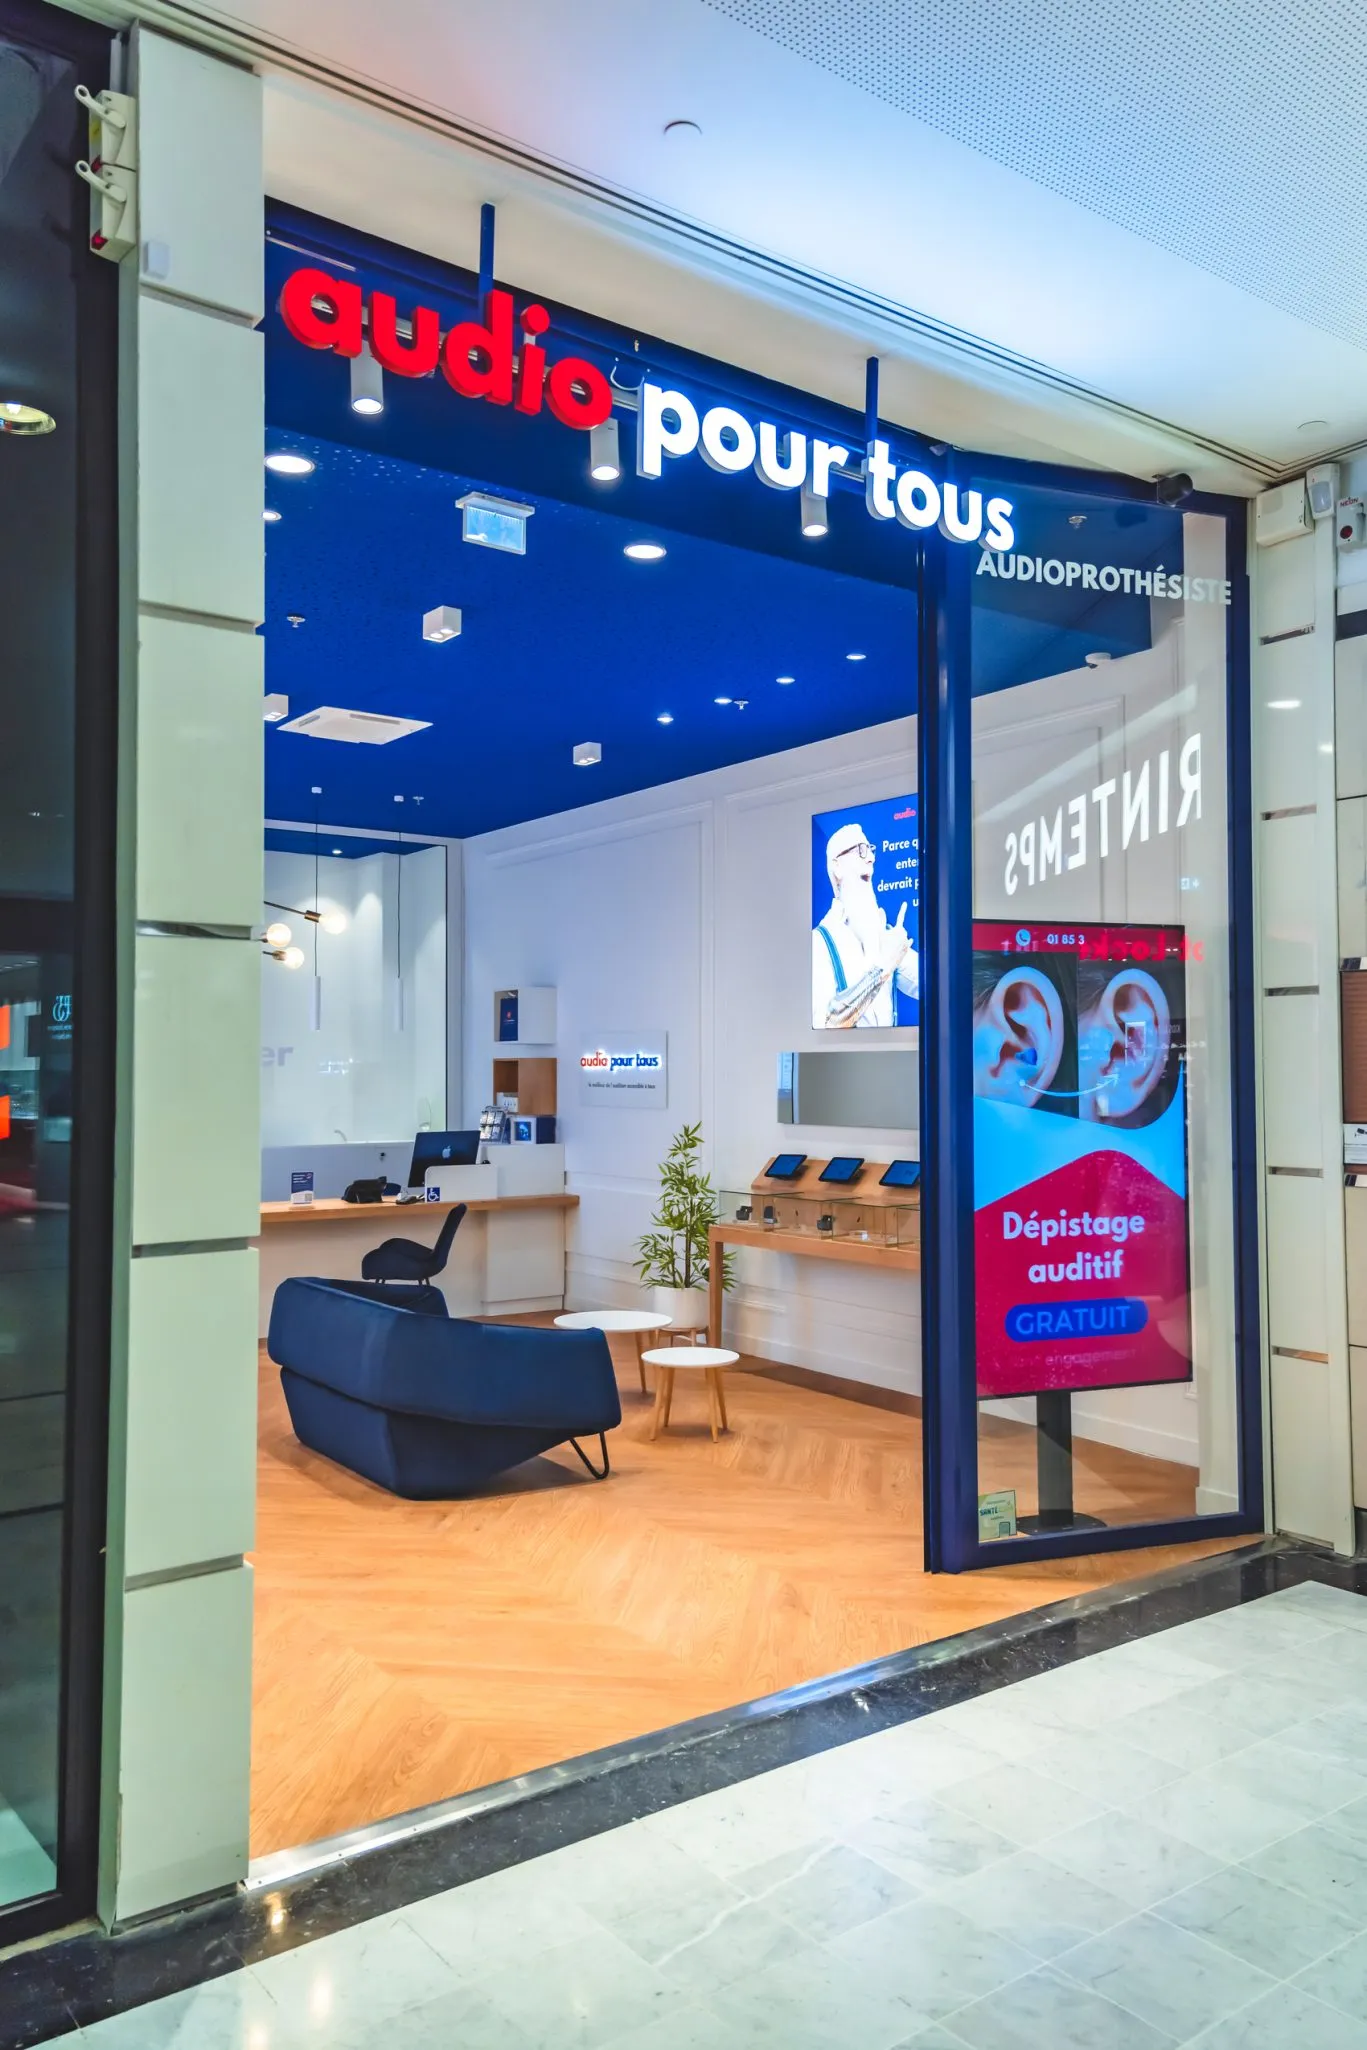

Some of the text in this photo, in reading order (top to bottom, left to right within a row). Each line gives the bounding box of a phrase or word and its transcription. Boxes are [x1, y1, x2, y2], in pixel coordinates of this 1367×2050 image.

[281, 267, 1015, 553] audio pour tous
[975, 551, 1233, 605] AUDIOPROTHÉSISTE
[882, 839, 910, 852] Parce
[896, 858, 918, 869] ente
[877, 876, 912, 892] devrait
[1047, 934, 1058, 945] 01
[1062, 934, 1075, 945] 85
[580, 1051, 659, 1071] audio pour tous
[1003, 1209, 1145, 1246] Dépistage
[1028, 1249, 1124, 1283] auditif
[1015, 1305, 1131, 1335] GRATUIT
